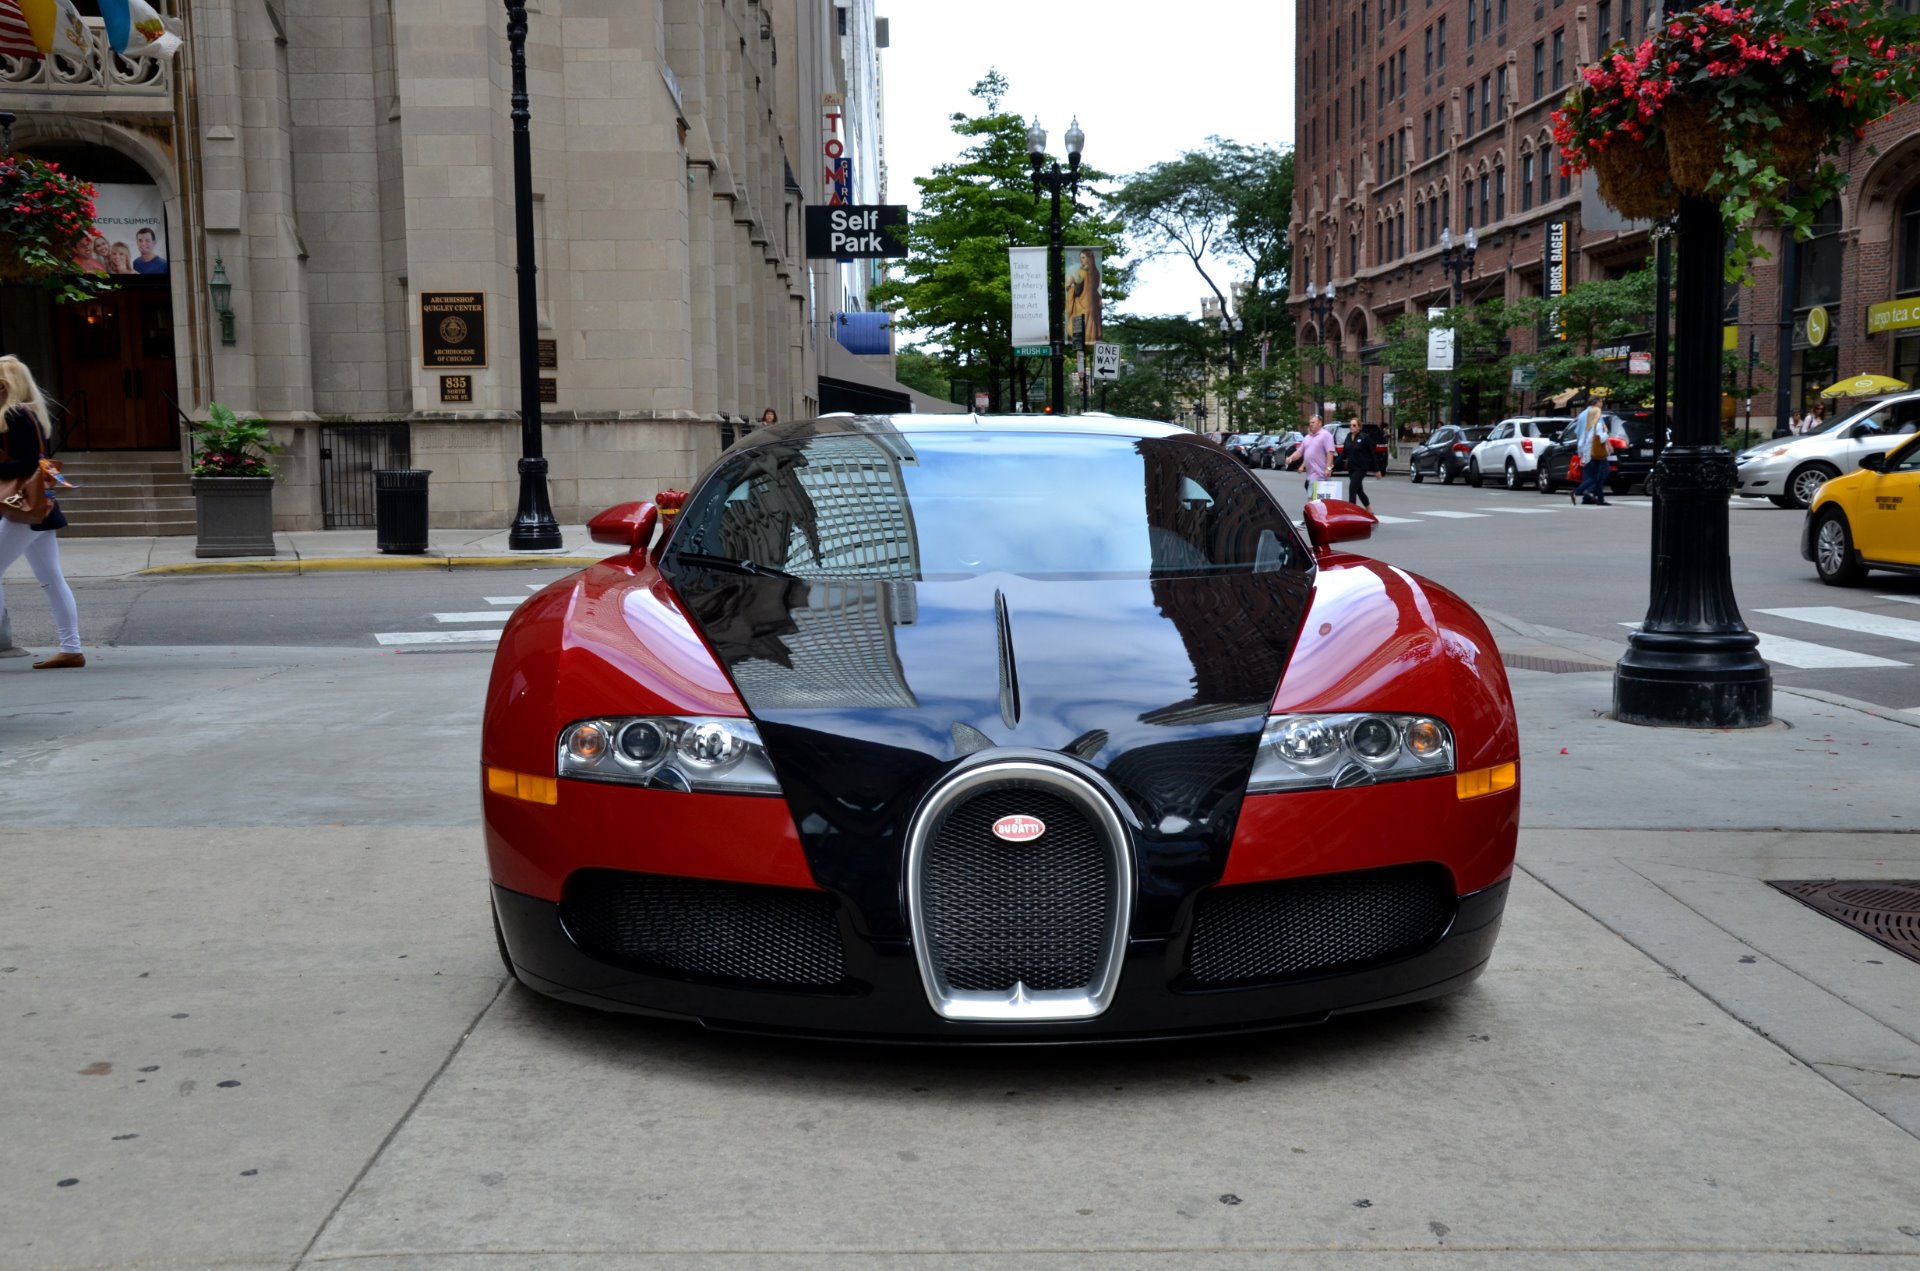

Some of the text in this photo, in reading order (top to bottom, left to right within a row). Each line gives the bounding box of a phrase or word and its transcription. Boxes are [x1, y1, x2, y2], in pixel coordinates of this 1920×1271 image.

[841, 160, 849, 205] GHIRA
[92, 217, 123, 225] ACEFUL
[830, 210, 878, 231] Self
[830, 232, 883, 252] Park
[1550, 223, 1563, 261] BAGELS
[1013, 262, 1029, 270] Take
[1013, 272, 1041, 280] the Year
[1022, 282, 1044, 291] Mercy
[423, 304, 482, 313] QUIGLEY CENTER
[1014, 301, 1038, 310] the Art
[1014, 311, 1043, 319] Institute
[1021, 347, 1041, 356] RUSH
[1098, 346, 1118, 356] ONE
[1097, 356, 1118, 365] WAY
[446, 377, 466, 388] 835
[998, 824, 1039, 833] BUGATTI
